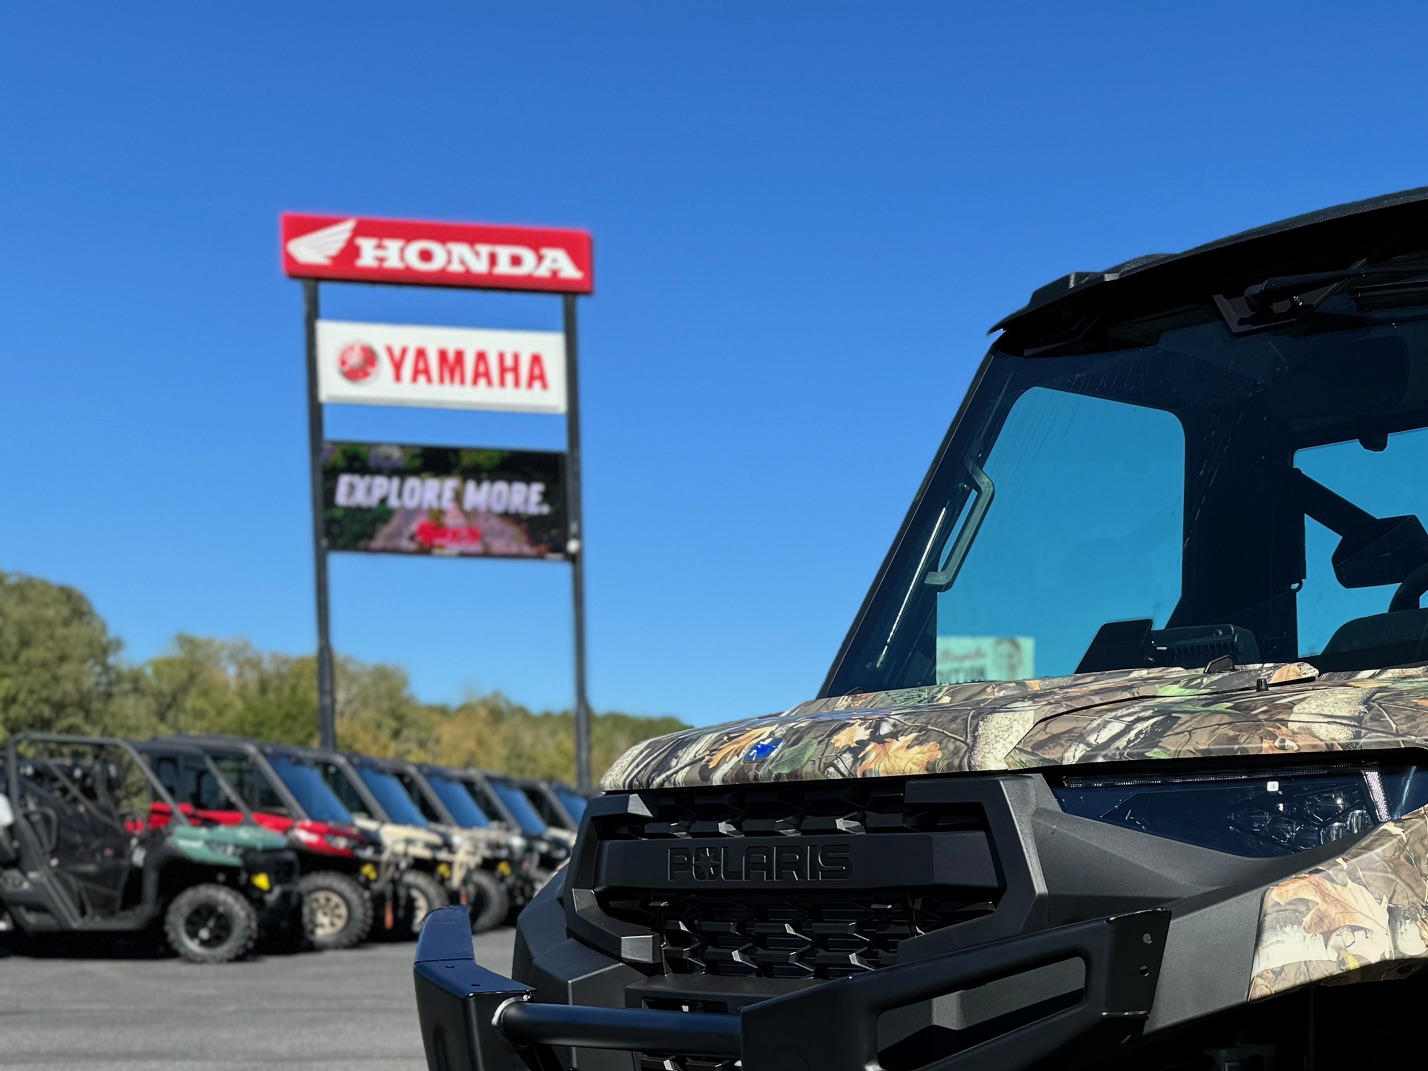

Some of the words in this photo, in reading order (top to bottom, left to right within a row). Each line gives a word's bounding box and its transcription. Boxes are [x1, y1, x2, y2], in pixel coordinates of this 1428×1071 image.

[354, 236, 584, 280] HONDA
[384, 345, 550, 391] YAMAHA
[334, 473, 459, 510] EXPLORE
[462, 478, 552, 516] MORE.
[667, 844, 854, 882] POLARIS
